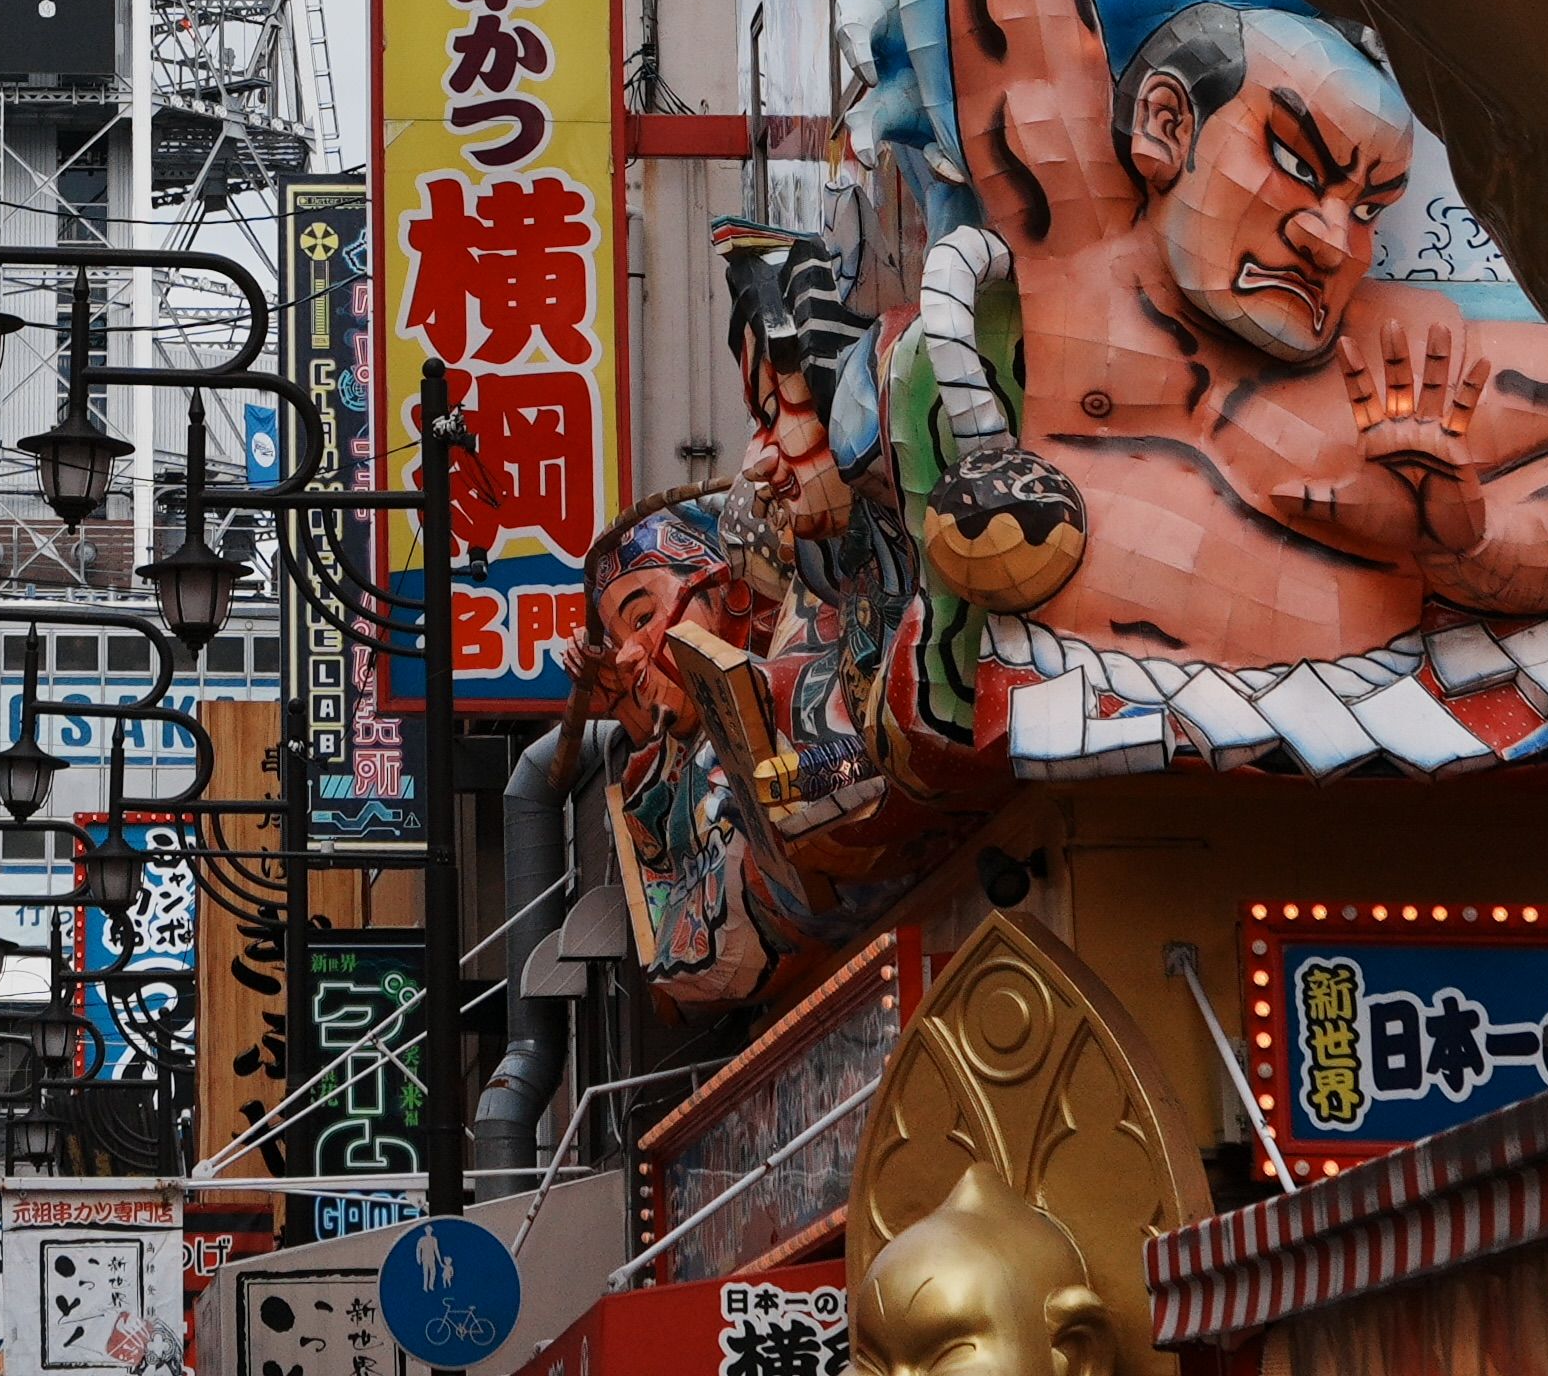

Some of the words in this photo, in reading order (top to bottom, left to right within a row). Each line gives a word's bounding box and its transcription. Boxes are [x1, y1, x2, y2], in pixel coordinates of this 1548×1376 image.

[407, 178, 593, 558] 横綱
[314, 659, 339, 757] LAB
[1306, 967, 1364, 1123] 新世界
[12, 1200, 174, 1225] 元祖串カツ専門店
[724, 1288, 849, 1316] 日本一の
